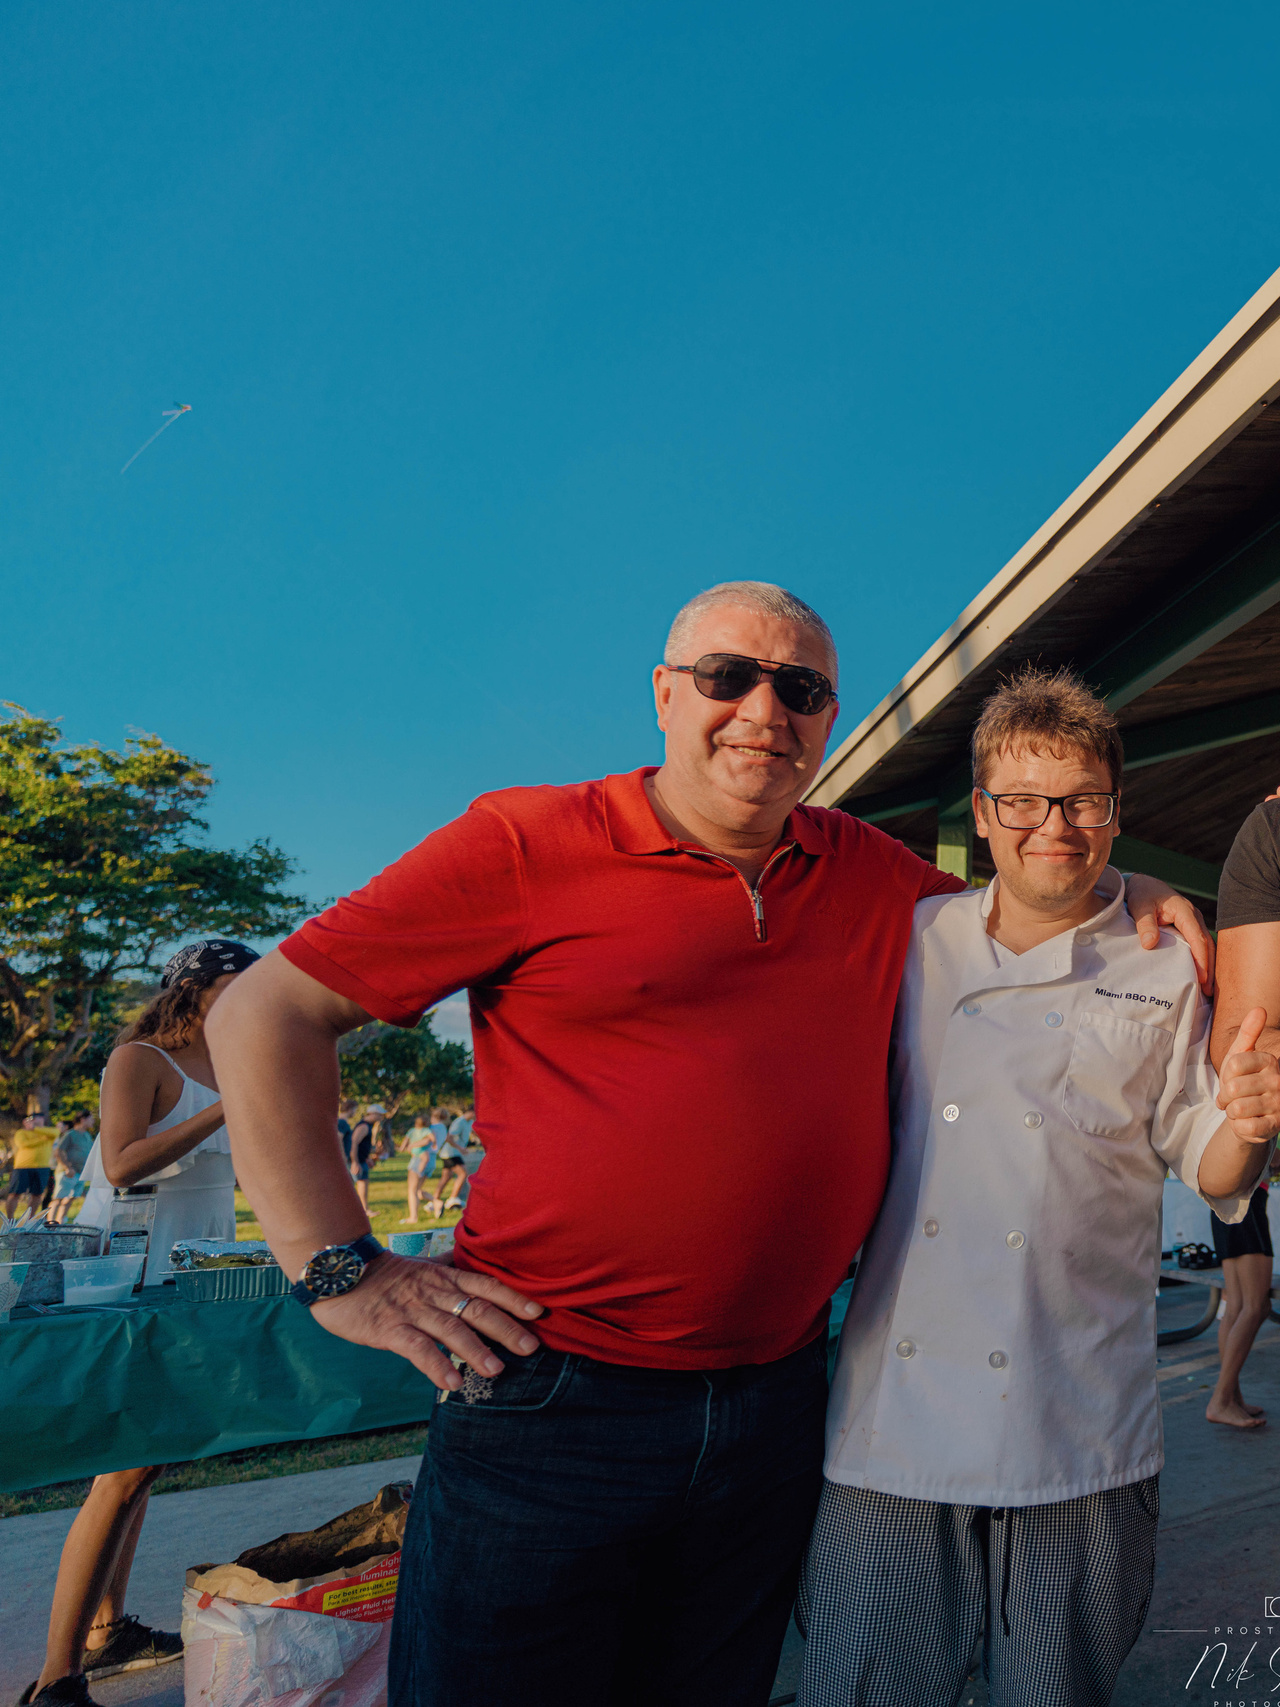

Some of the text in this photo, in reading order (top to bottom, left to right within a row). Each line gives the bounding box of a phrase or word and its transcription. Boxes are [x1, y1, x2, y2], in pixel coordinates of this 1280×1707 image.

[1094, 987, 1174, 1010] Miami BBQ Party
[380, 1556, 402, 1568] Ligh
[360, 1568, 399, 1582] Iluminac
[342, 1588, 358, 1597] best
[335, 1606, 361, 1617] Lighter
[362, 1600, 380, 1611] Fluid
